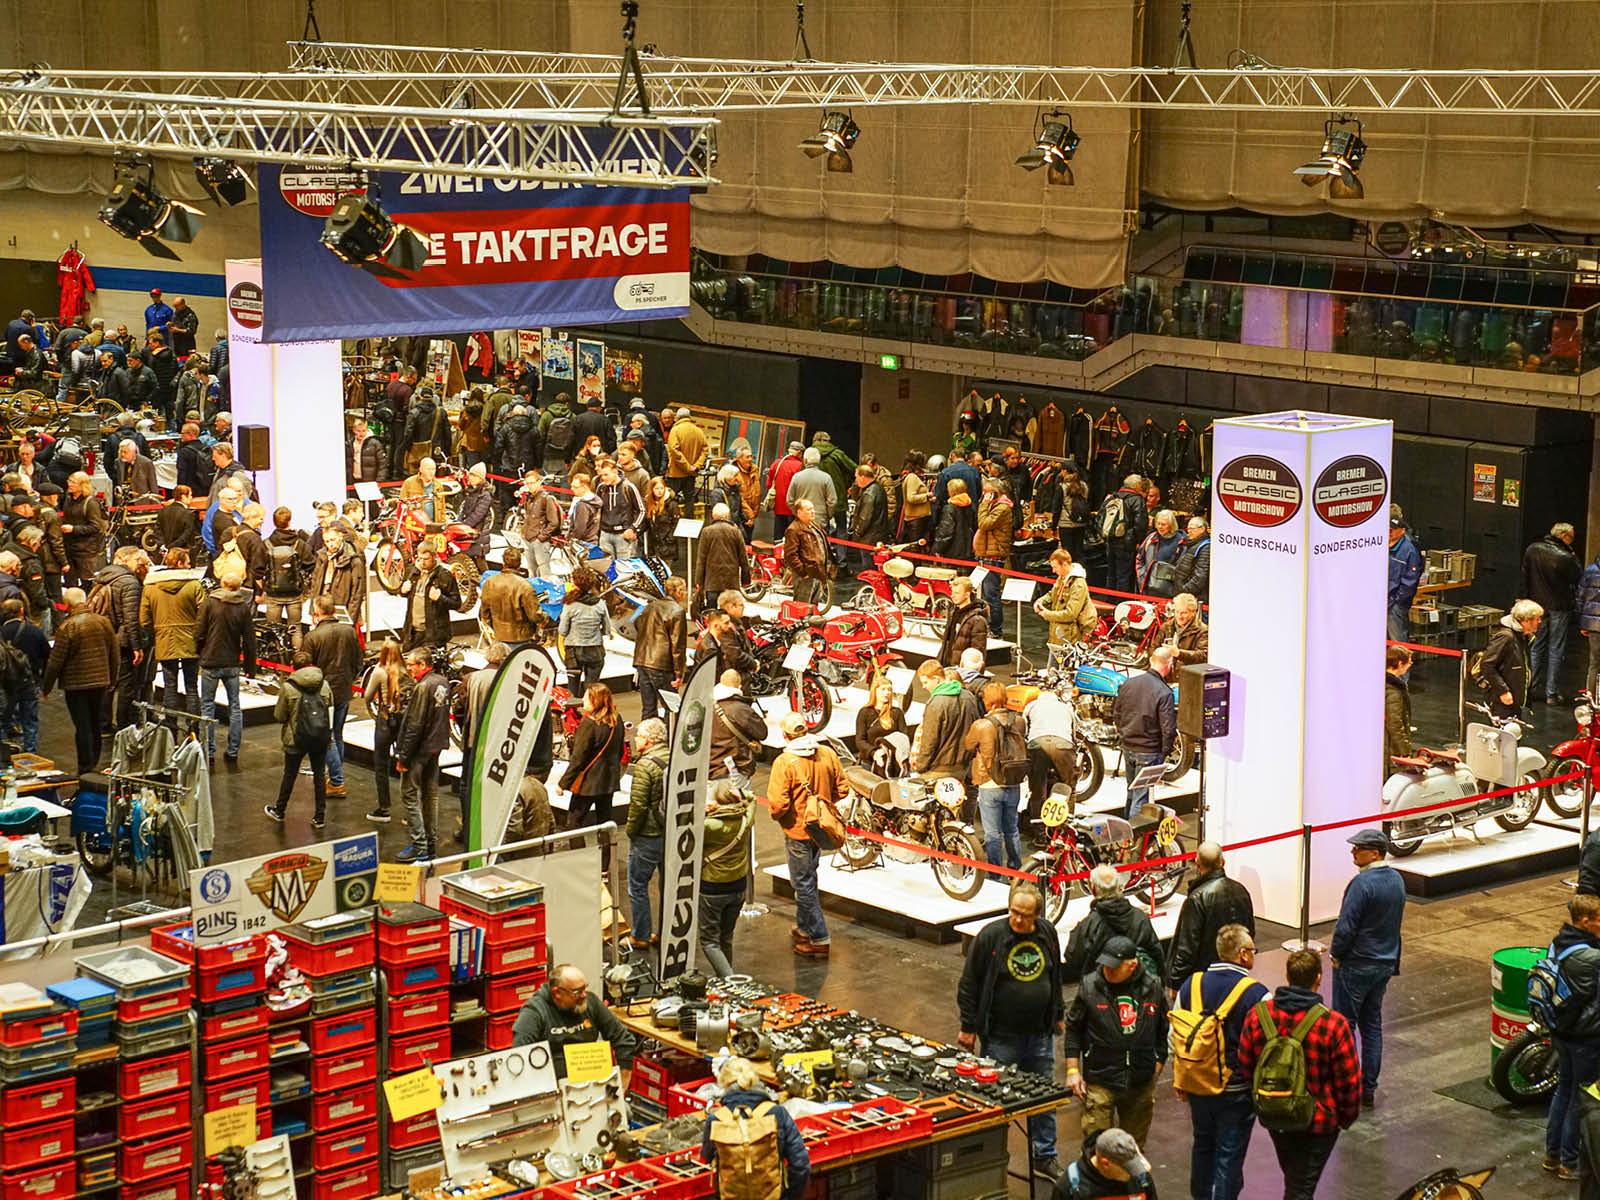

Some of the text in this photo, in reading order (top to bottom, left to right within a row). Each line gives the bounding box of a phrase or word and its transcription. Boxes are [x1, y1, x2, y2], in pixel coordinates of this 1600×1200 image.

[453, 222, 668, 265] TAKTFRAGE
[1243, 467, 1277, 481] BREMEN
[1336, 467, 1366, 481] BREMEN
[1223, 483, 1296, 500] CLASSIC
[1318, 482, 1383, 500] CLASSIC
[1233, 500, 1285, 517] MOTORSHOW
[1328, 501, 1373, 517] MOTORSHOW
[1218, 533, 1297, 555] SONDERSCHAU
[1313, 535, 1383, 555] SONDERSCHAU
[487, 659, 544, 788] Benelli
[943, 783, 955, 793] 28
[1042, 802, 1066, 823] 649
[662, 767, 699, 981] Benelli
[196, 911, 237, 937] BING
[243, 916, 266, 931] 1842
